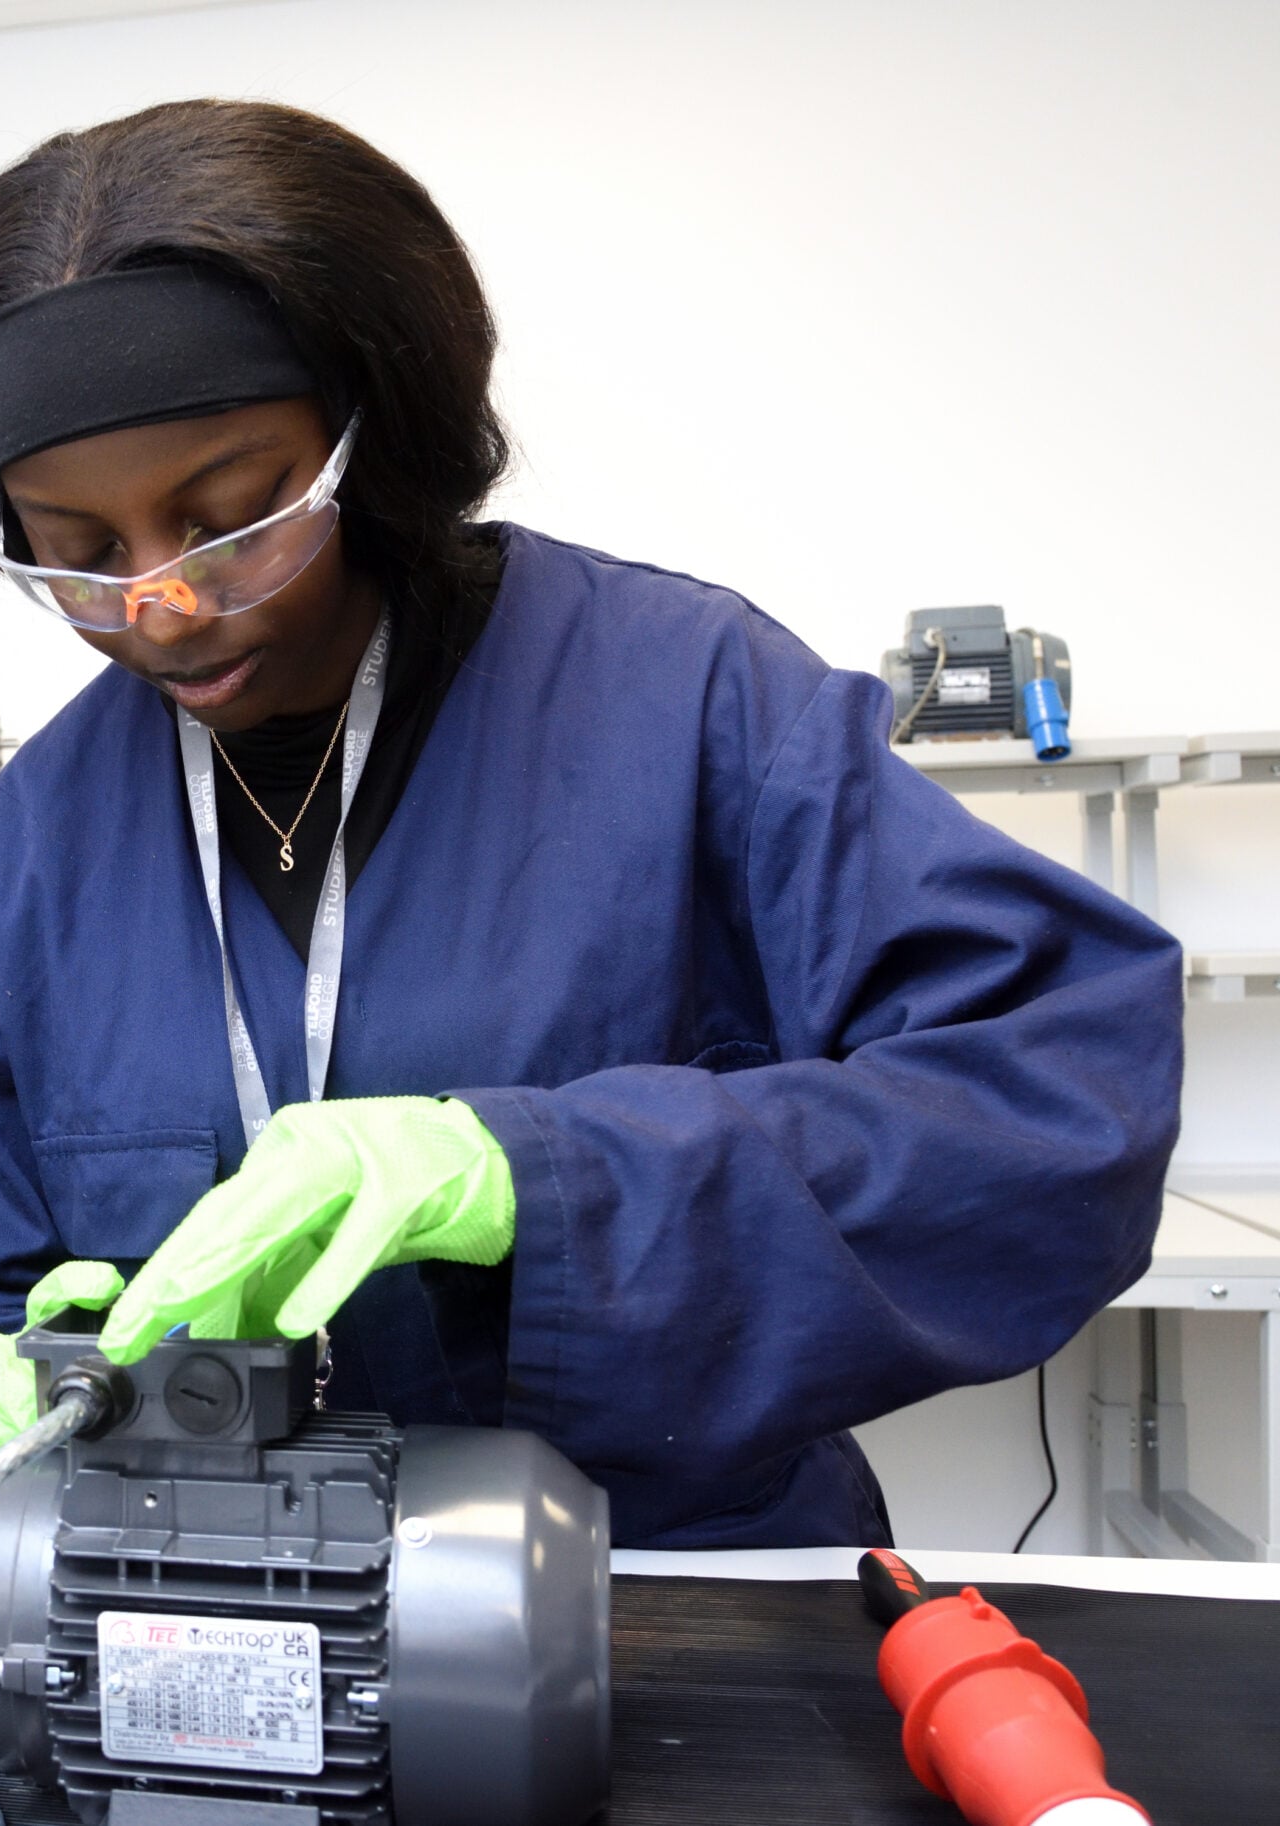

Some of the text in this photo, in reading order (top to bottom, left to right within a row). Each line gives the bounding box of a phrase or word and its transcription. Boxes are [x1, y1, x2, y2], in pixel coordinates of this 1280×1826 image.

[362, 612, 392, 687] STUDEN
[342, 729, 357, 795] TELFORD
[189, 774, 208, 838] COLLEGE
[200, 769, 216, 834] TELFORD
[280, 845, 295, 872] S
[308, 973, 324, 1040] TELFORD
[317, 974, 337, 1040] COLLEGE
[147, 1625, 179, 1644] TEC
[283, 1630, 308, 1644] UK
[283, 1643, 310, 1657] CA
